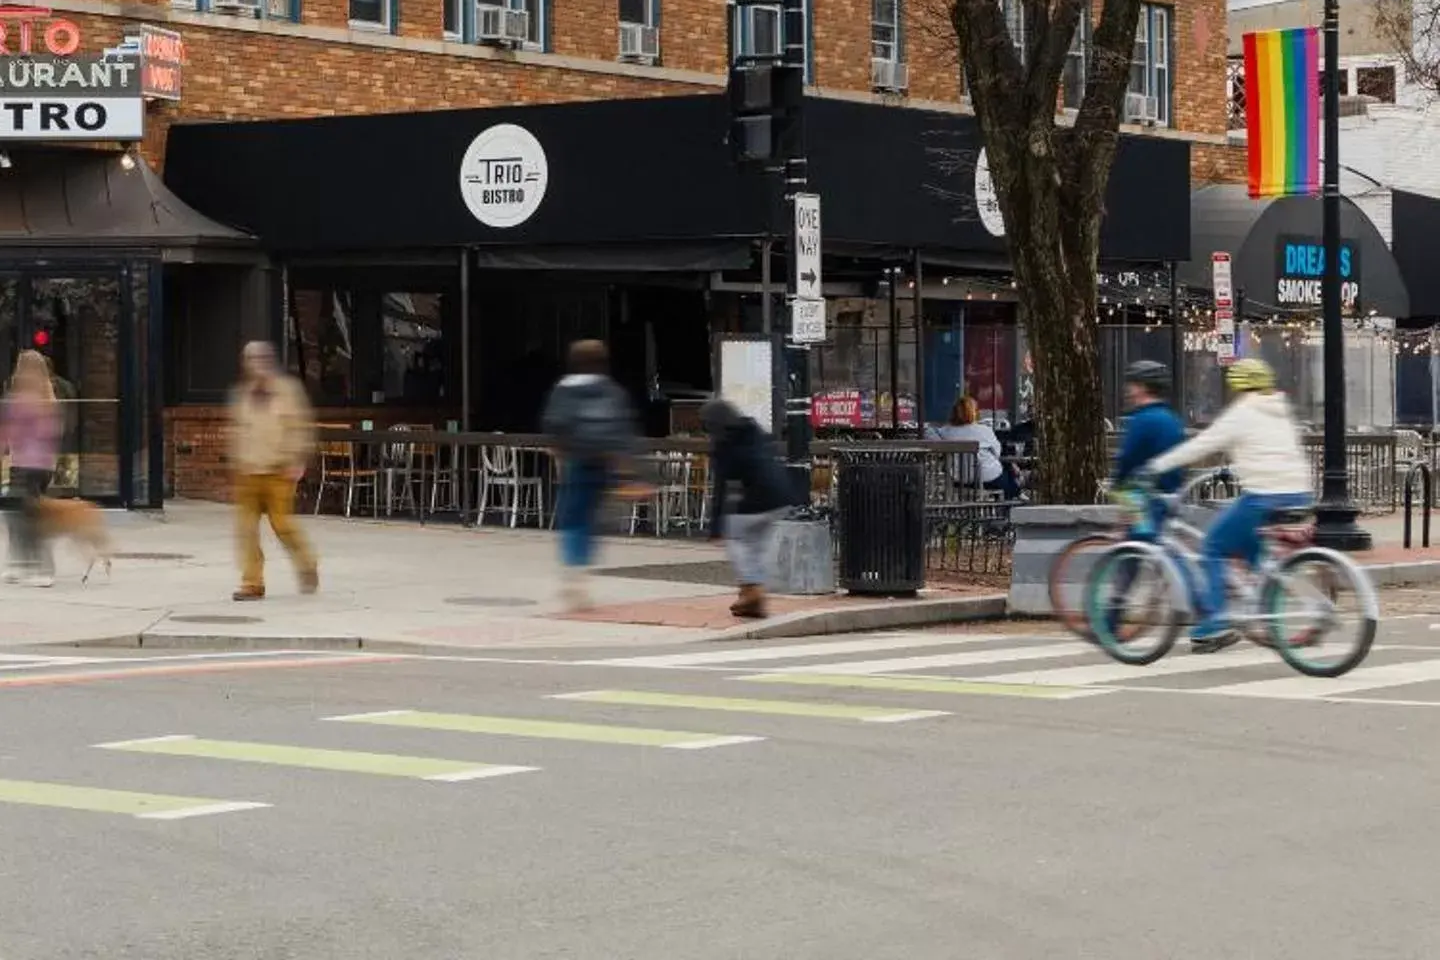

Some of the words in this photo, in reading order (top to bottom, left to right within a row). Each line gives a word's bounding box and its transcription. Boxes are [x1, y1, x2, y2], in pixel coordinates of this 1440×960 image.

[479, 157, 523, 184] TRIO
[482, 188, 525, 205] BISTRO
[798, 207, 818, 230] ONE
[799, 235, 817, 256] WAY
[1285, 243, 1352, 277] DREAS
[1278, 279, 1322, 303] SMOKE
